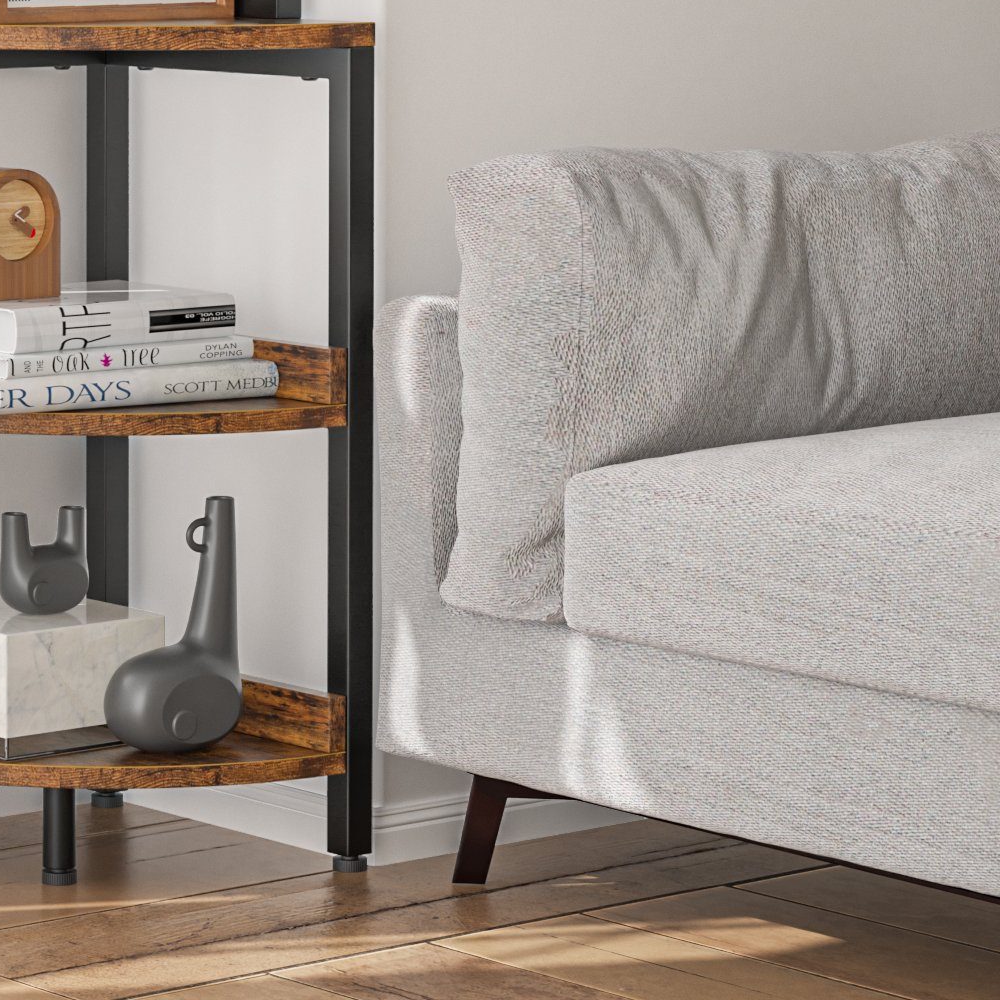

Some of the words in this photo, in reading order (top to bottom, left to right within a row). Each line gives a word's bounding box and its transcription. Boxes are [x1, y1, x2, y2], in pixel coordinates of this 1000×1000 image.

[205, 342, 237, 352] DYLAN
[199, 350, 243, 360] COPPING
[45, 380, 131, 406] DAYS
[164, 380, 222, 395] SCOTT
